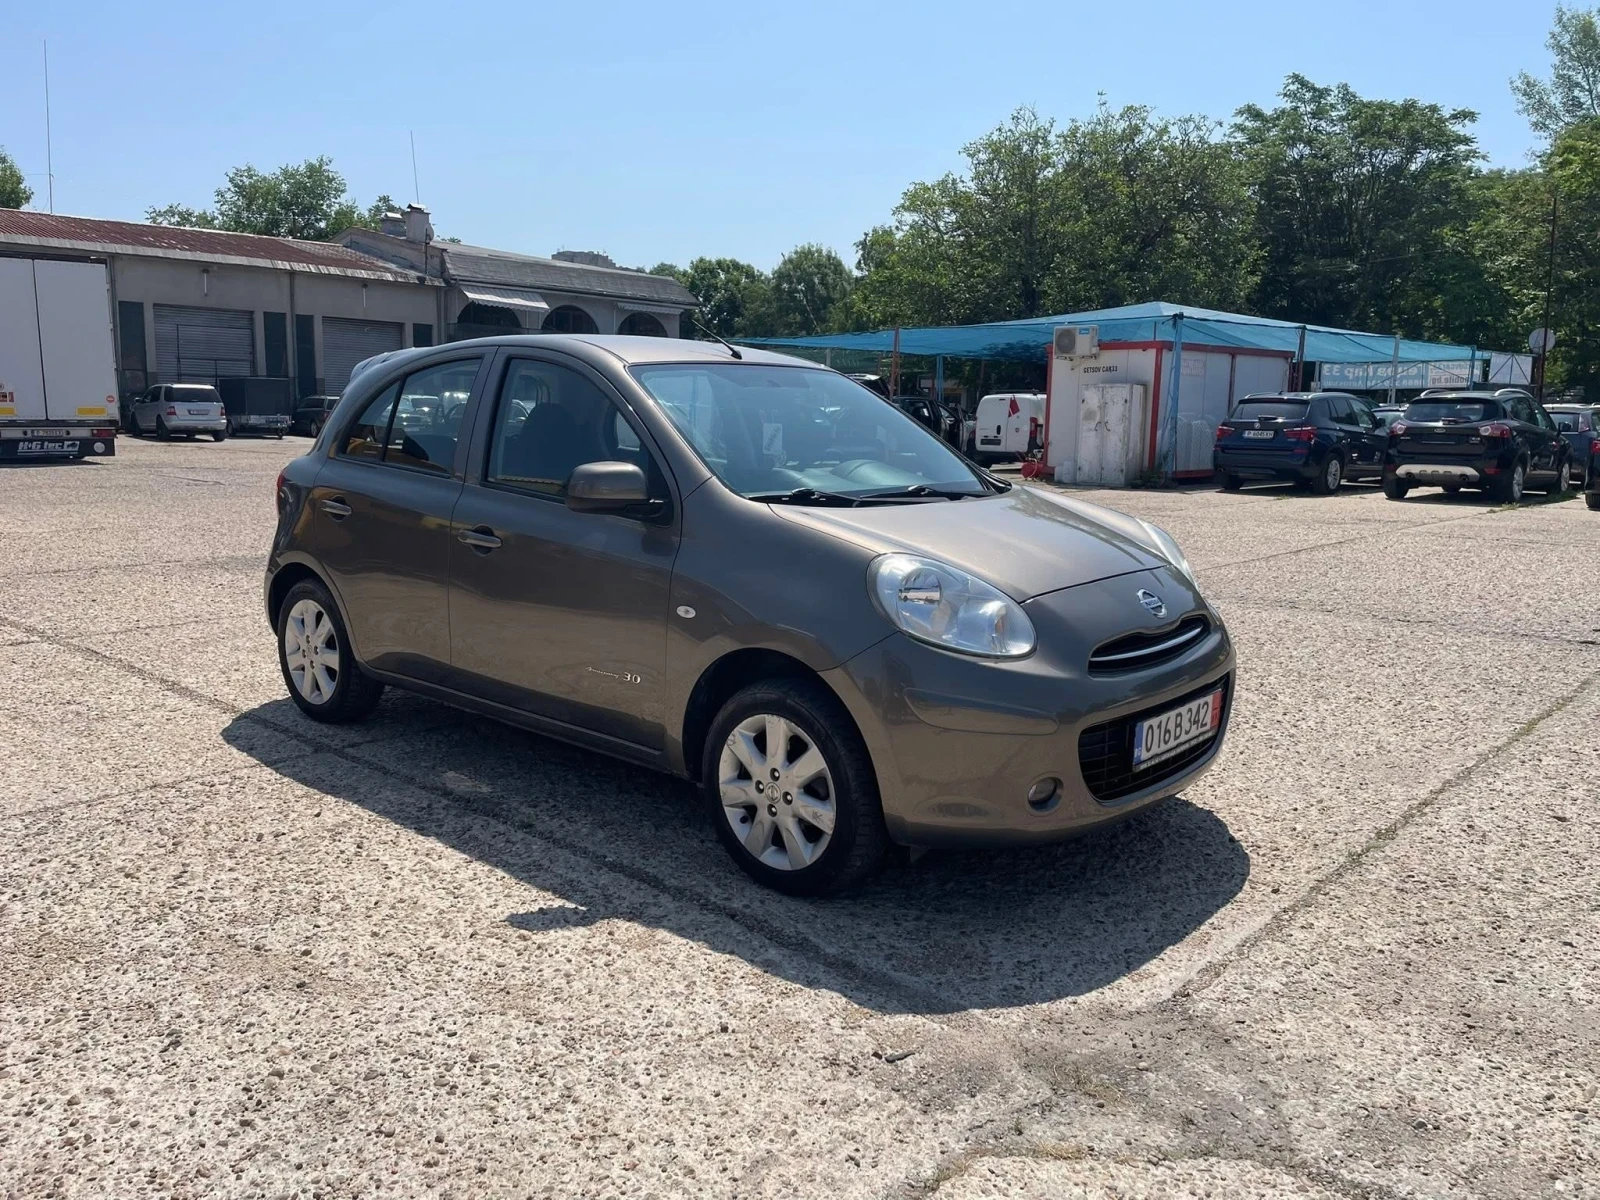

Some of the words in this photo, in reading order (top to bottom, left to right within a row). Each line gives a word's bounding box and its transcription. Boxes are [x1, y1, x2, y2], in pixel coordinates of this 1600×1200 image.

[1083, 366, 1101, 374] GETSOV
[622, 671, 641, 684] 30
[1145, 701, 1209, 753] 016B342
